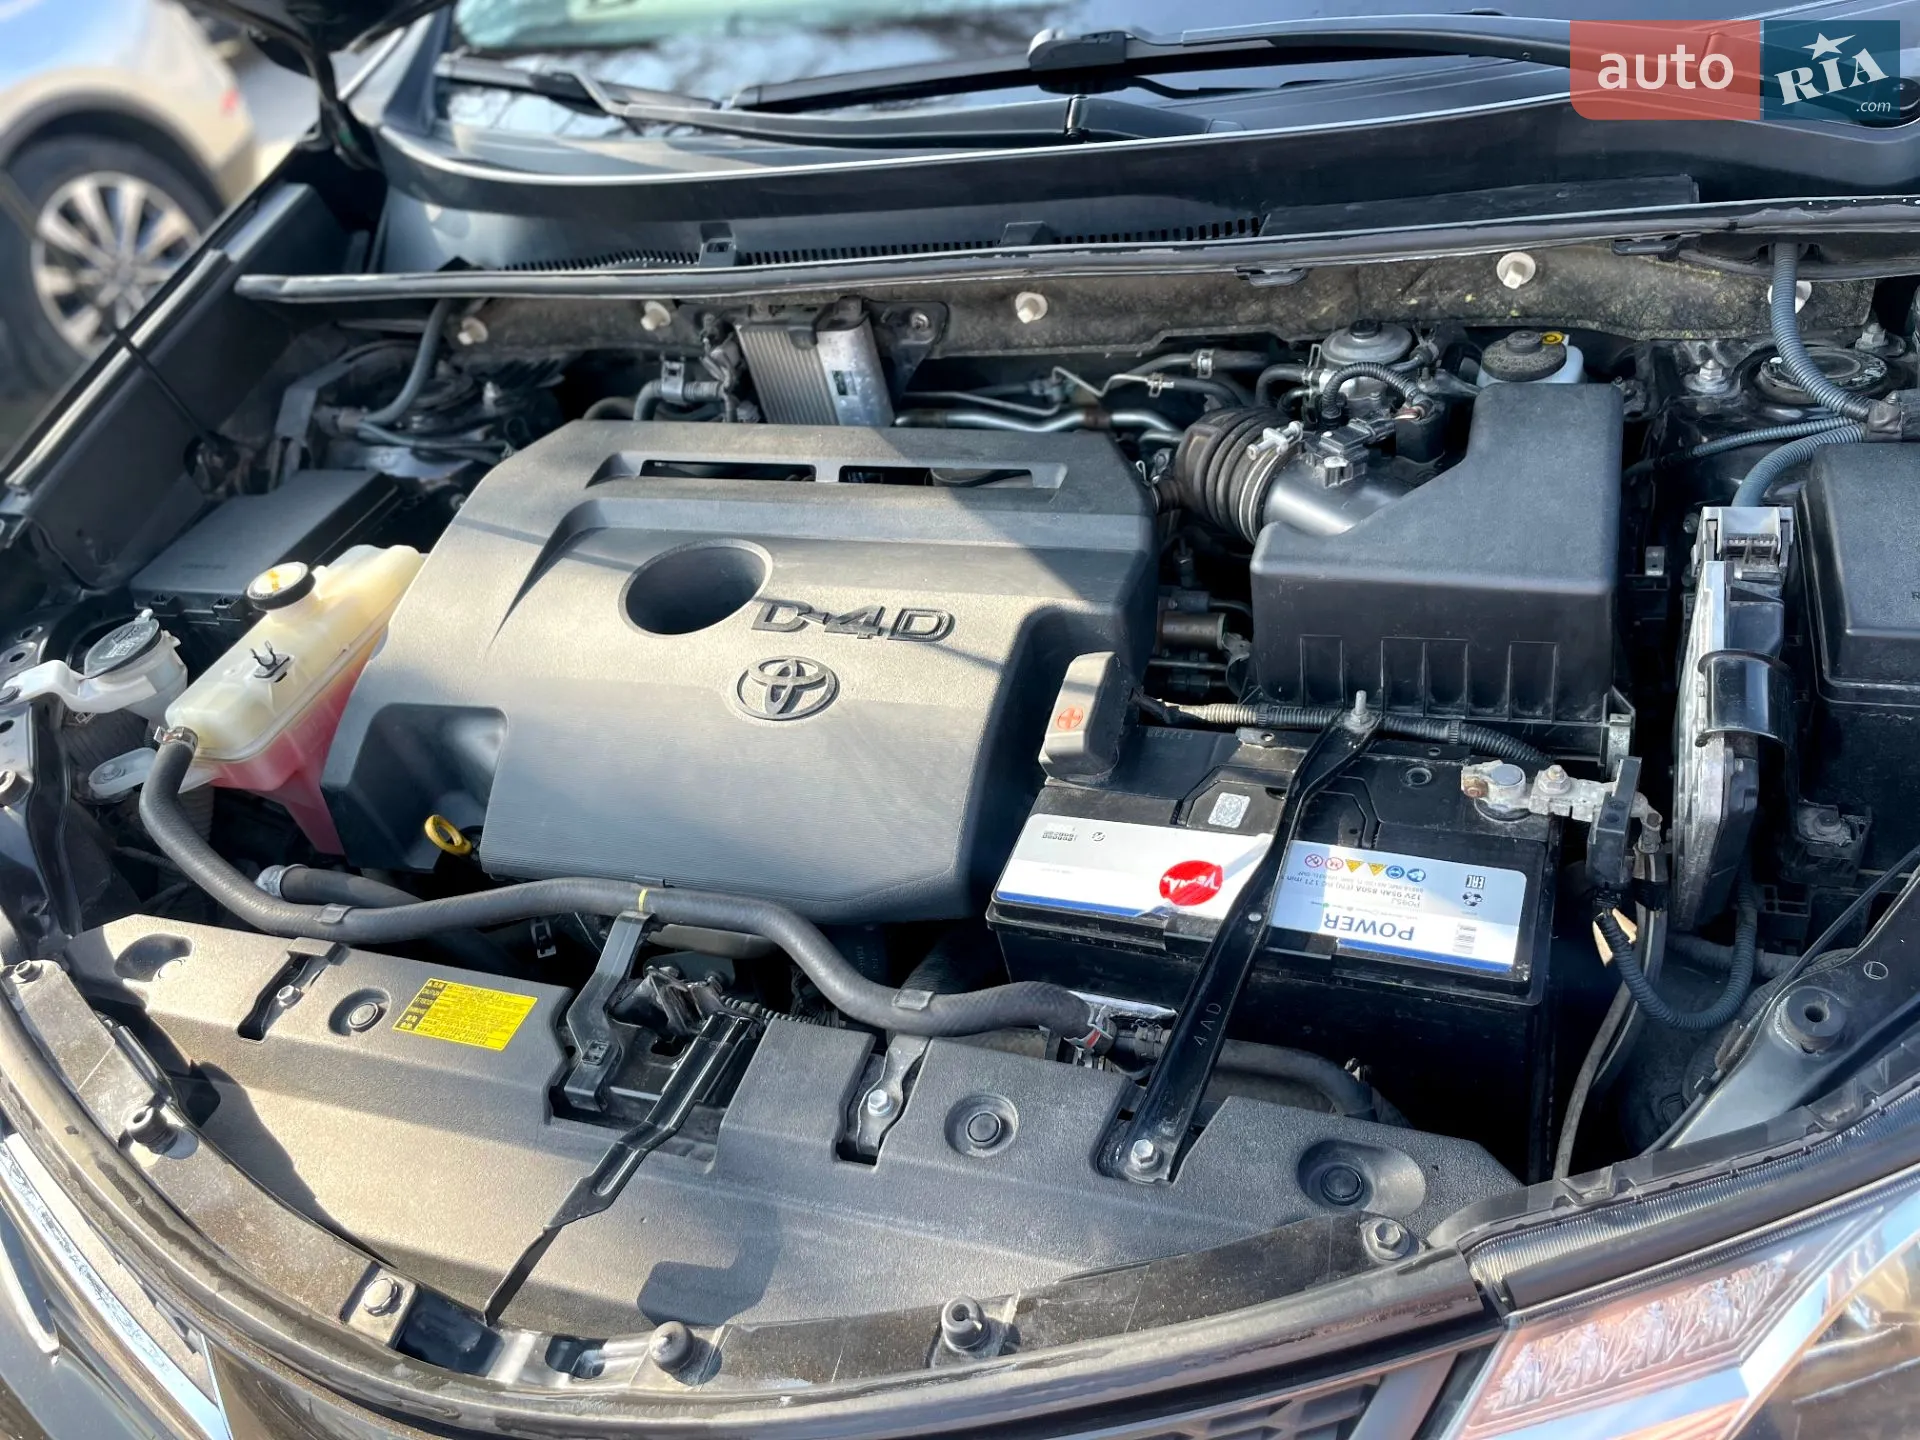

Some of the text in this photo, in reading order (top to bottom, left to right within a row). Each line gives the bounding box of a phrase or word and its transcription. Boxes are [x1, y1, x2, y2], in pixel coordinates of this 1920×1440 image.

[751, 599, 956, 643] D-4D
[1465, 874, 1485, 889] EAC
[1324, 913, 1415, 941] POWER
